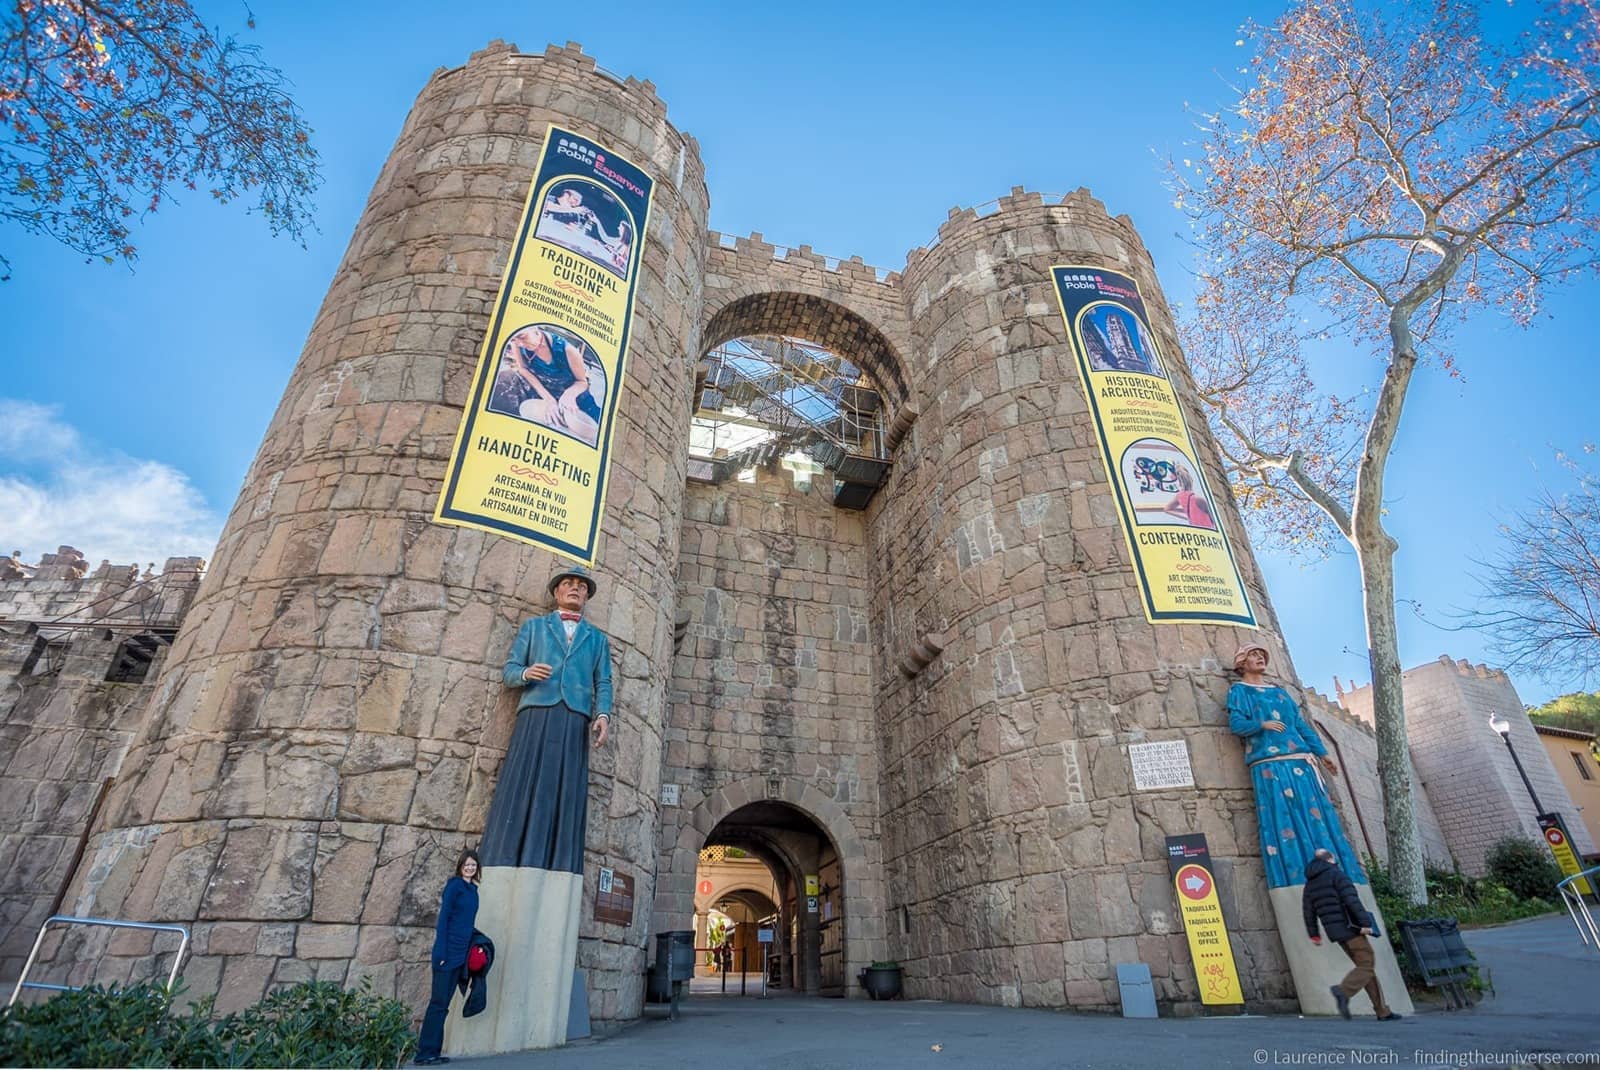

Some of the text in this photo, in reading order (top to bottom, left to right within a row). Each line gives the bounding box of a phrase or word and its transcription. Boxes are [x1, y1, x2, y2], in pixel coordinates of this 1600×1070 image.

[557, 146, 645, 198] Poble Espanyol
[541, 246, 618, 293] TRADITIONAL
[553, 265, 604, 298] CUISINE
[1066, 282, 1095, 290] Poble
[525, 280, 616, 325] GASTRONOMIA TRADICIONAL
[513, 296, 618, 346] GASTRONOMIE TRADITIONNELLE
[574, 308, 614, 336] TRADICIONAL
[1105, 376, 1164, 392] HISTORICAL
[1101, 388, 1174, 405] ARCHITECTURE
[526, 430, 559, 454] LIVE
[478, 436, 591, 488] HANDCRAFTING
[494, 474, 566, 505] ARTESANIA EN VIU
[480, 498, 568, 532] ARTISANAT EN DIRECT
[536, 500, 547, 512] EN
[550, 504, 567, 518] VIVO
[1140, 532, 1224, 551] CONTEMPORARY
[1180, 548, 1201, 561] ART
[1168, 585, 1182, 594] ARTE
[1175, 596, 1186, 604] ART
[1185, 904, 1216, 912] TAQUILLES
[1188, 917, 1220, 925] TAQUILLAS
